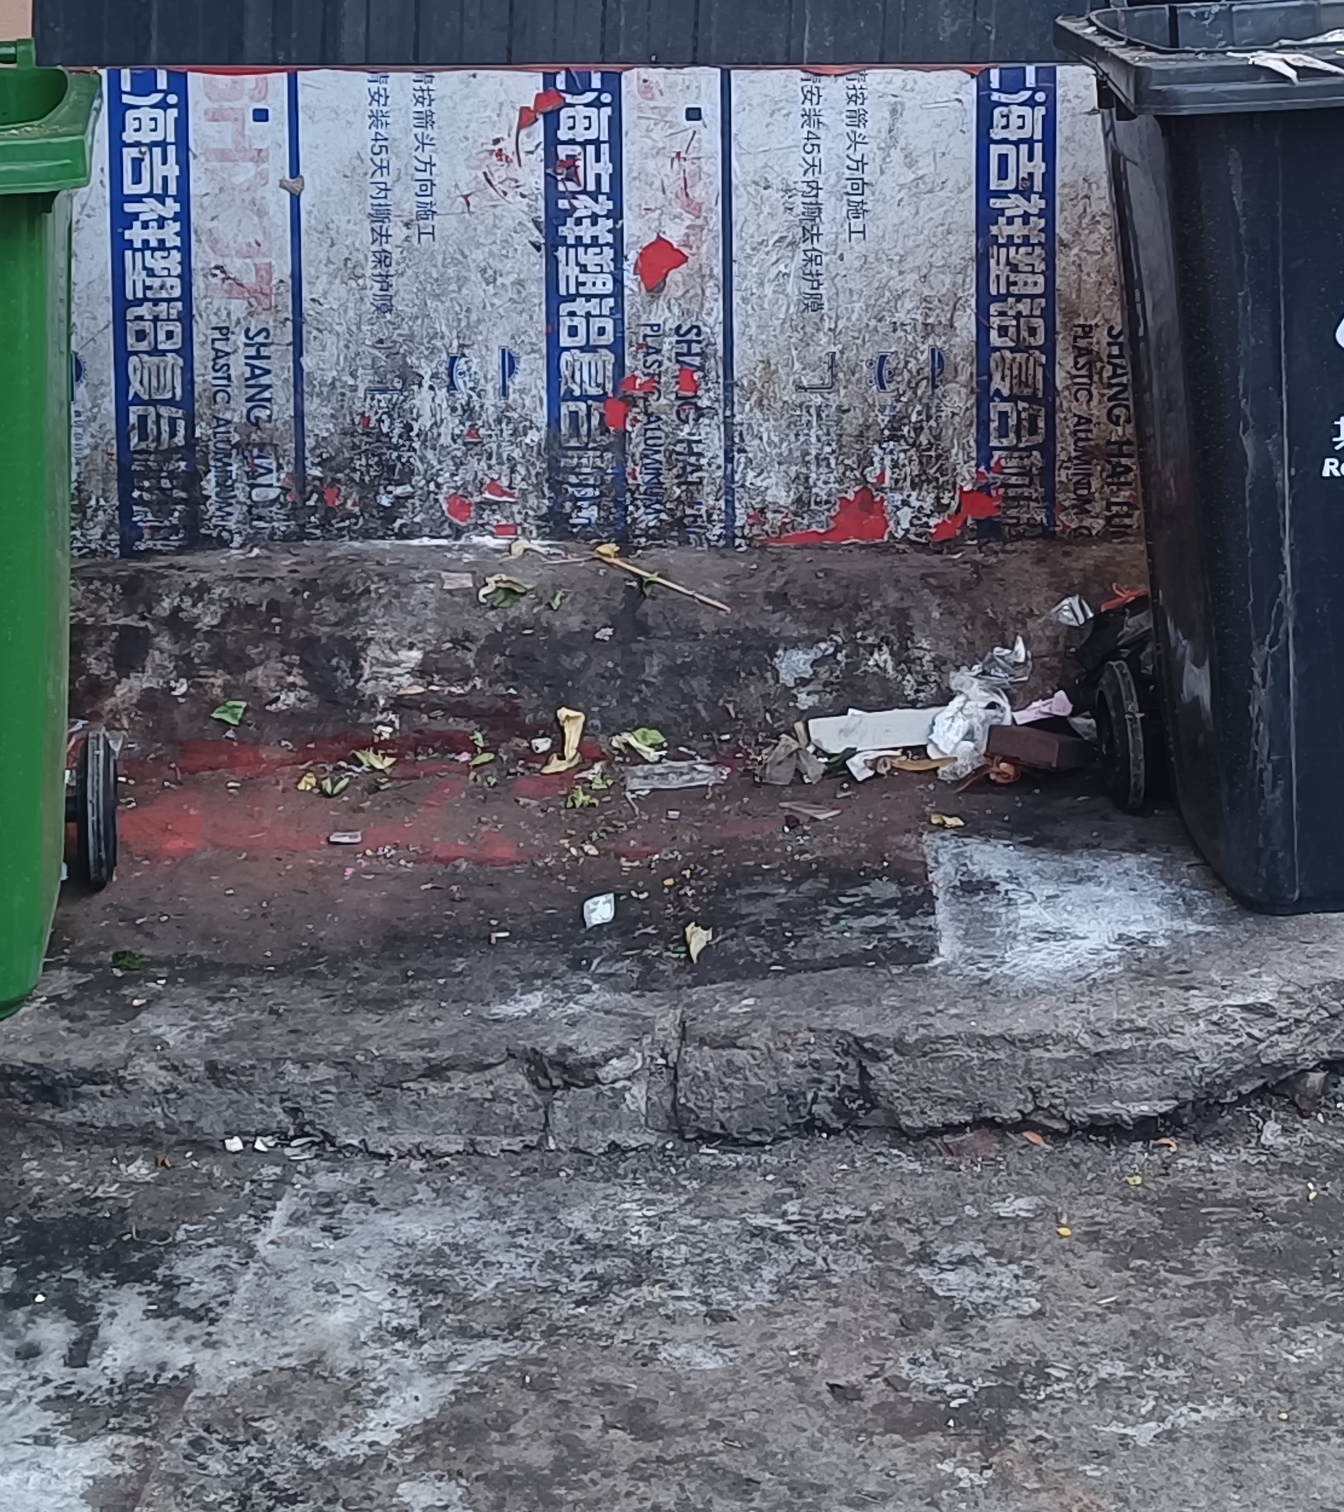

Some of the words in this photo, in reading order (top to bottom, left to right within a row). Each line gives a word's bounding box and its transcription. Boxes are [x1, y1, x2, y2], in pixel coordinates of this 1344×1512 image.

[121, 69, 187, 553] 海吉祥塑铝复合
[554, 71, 617, 530] 海吉祥塑铝复合
[210, 326, 234, 405] PLASTIC
[243, 326, 273, 428] SHANG
[641, 323, 663, 403] PLASTC
[1072, 323, 1094, 405] PLASTIC
